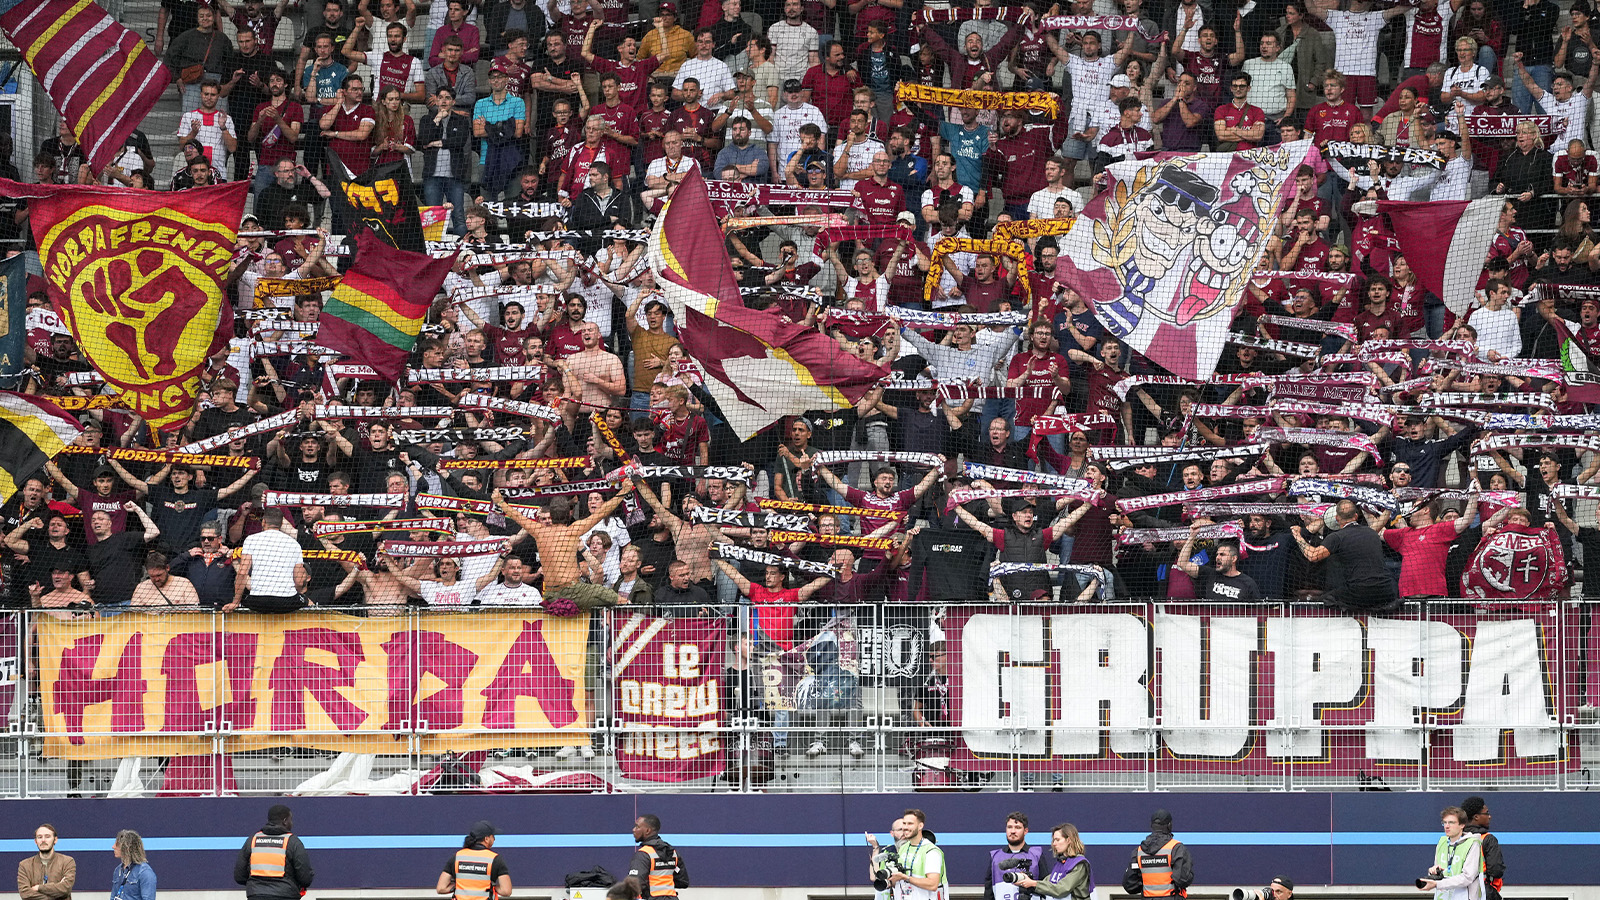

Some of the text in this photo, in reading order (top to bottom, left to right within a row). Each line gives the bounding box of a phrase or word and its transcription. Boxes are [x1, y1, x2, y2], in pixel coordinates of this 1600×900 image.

[899, 84, 965, 107] METZ
[50, 224, 107, 294] HORDA
[40, 313, 60, 327] ICI
[1277, 384, 1366, 405] ALLEZ METZ
[1481, 434, 1528, 449] METZ
[112, 448, 251, 475] HORDA FRENETIK
[445, 457, 586, 470] HORDA FRENETIK
[541, 481, 612, 495] FRENETIK
[1553, 484, 1597, 498] METZ
[266, 491, 333, 506] METZ
[418, 495, 458, 509] HORDA
[760, 498, 902, 521] HORDA FRENETIK
[316, 523, 368, 537] HORDA
[770, 530, 894, 550] HORDA FRENETIK
[391, 544, 438, 555] TRIBUNE
[441, 543, 462, 554] EST
[53, 620, 579, 744] HORDA
[962, 612, 1566, 763] GRUPPA
